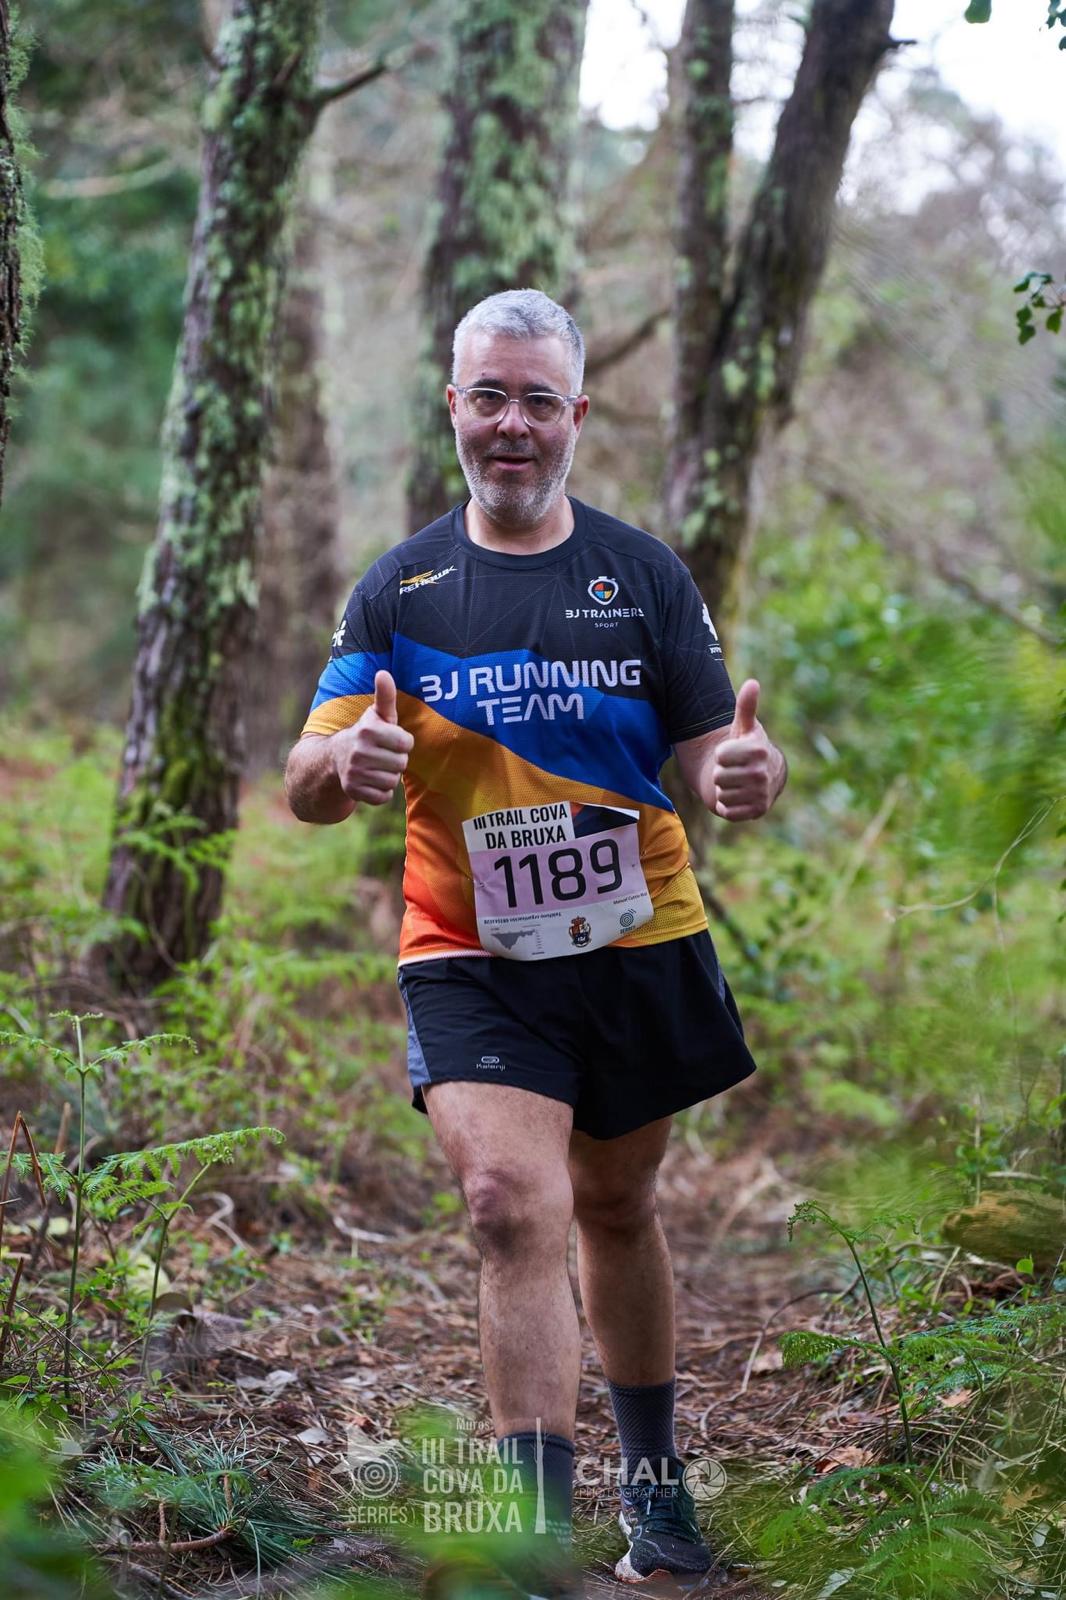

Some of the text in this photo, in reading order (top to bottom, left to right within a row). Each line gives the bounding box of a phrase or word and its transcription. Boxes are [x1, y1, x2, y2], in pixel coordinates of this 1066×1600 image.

[581, 607, 645, 618] TRAINERS
[469, 659, 642, 696] RUNNING
[476, 693, 585, 726] TEAM
[473, 803, 568, 830] III TRAIL COVA
[485, 824, 567, 849] DA BRUXA
[494, 838, 622, 909] 1189
